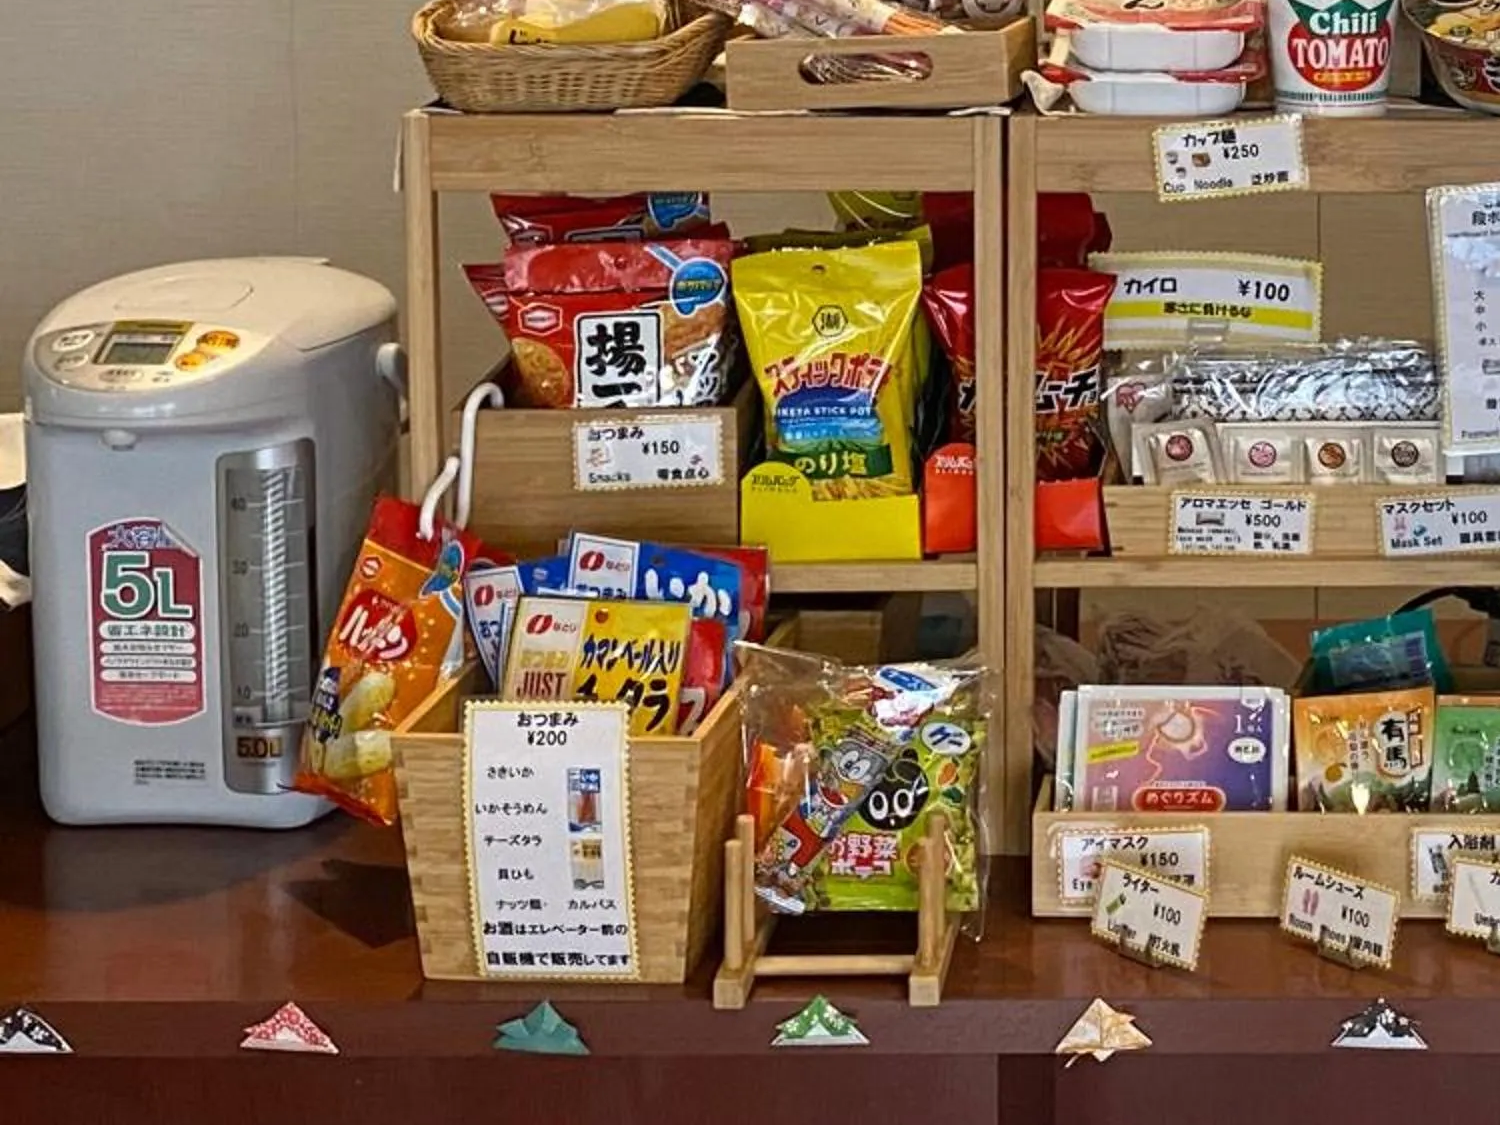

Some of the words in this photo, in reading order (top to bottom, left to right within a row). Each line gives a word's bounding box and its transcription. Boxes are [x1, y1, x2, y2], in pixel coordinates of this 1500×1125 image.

[1308, 10, 1379, 37] Chili
[1290, 36, 1391, 70] TOMATO
[1222, 143, 1259, 159] ¥250
[1123, 277, 1178, 294] カイロ
[1237, 279, 1290, 302] ¥100
[1474, 290, 1486, 302] 大
[585, 320, 647, 408] 揚一
[641, 440, 680, 455] ¥150
[795, 450, 868, 475] のり塩
[1382, 496, 1456, 514] マスクセット
[1244, 514, 1281, 528] ¥500
[1450, 510, 1488, 525] ¥100
[100, 550, 194, 619] 5L
[580, 634, 681, 676] カマンベール入り
[515, 672, 567, 698] JUST
[516, 712, 579, 727] おつまみ
[527, 730, 568, 746] ¥200
[1382, 717, 1407, 769] 有馬
[486, 765, 534, 779] さきいか
[1145, 790, 1215, 807] めぐりズム
[475, 802, 548, 815] いかそうめん
[483, 834, 542, 847] チーズタラ
[1080, 836, 1149, 851] アイマスク
[1447, 834, 1496, 850] 入浴剤
[1139, 851, 1180, 866] ¥150
[498, 868, 534, 881] 貝ひも
[1121, 874, 1160, 895] ライター
[1293, 866, 1364, 900] ルームシューズ
[567, 898, 617, 910] カルパス
[1153, 902, 1181, 925] ¥100
[1341, 905, 1370, 928] ¥100
[483, 921, 628, 937] お酒はエレベーター前の
[486, 952, 629, 967] 自販機で販売してます
